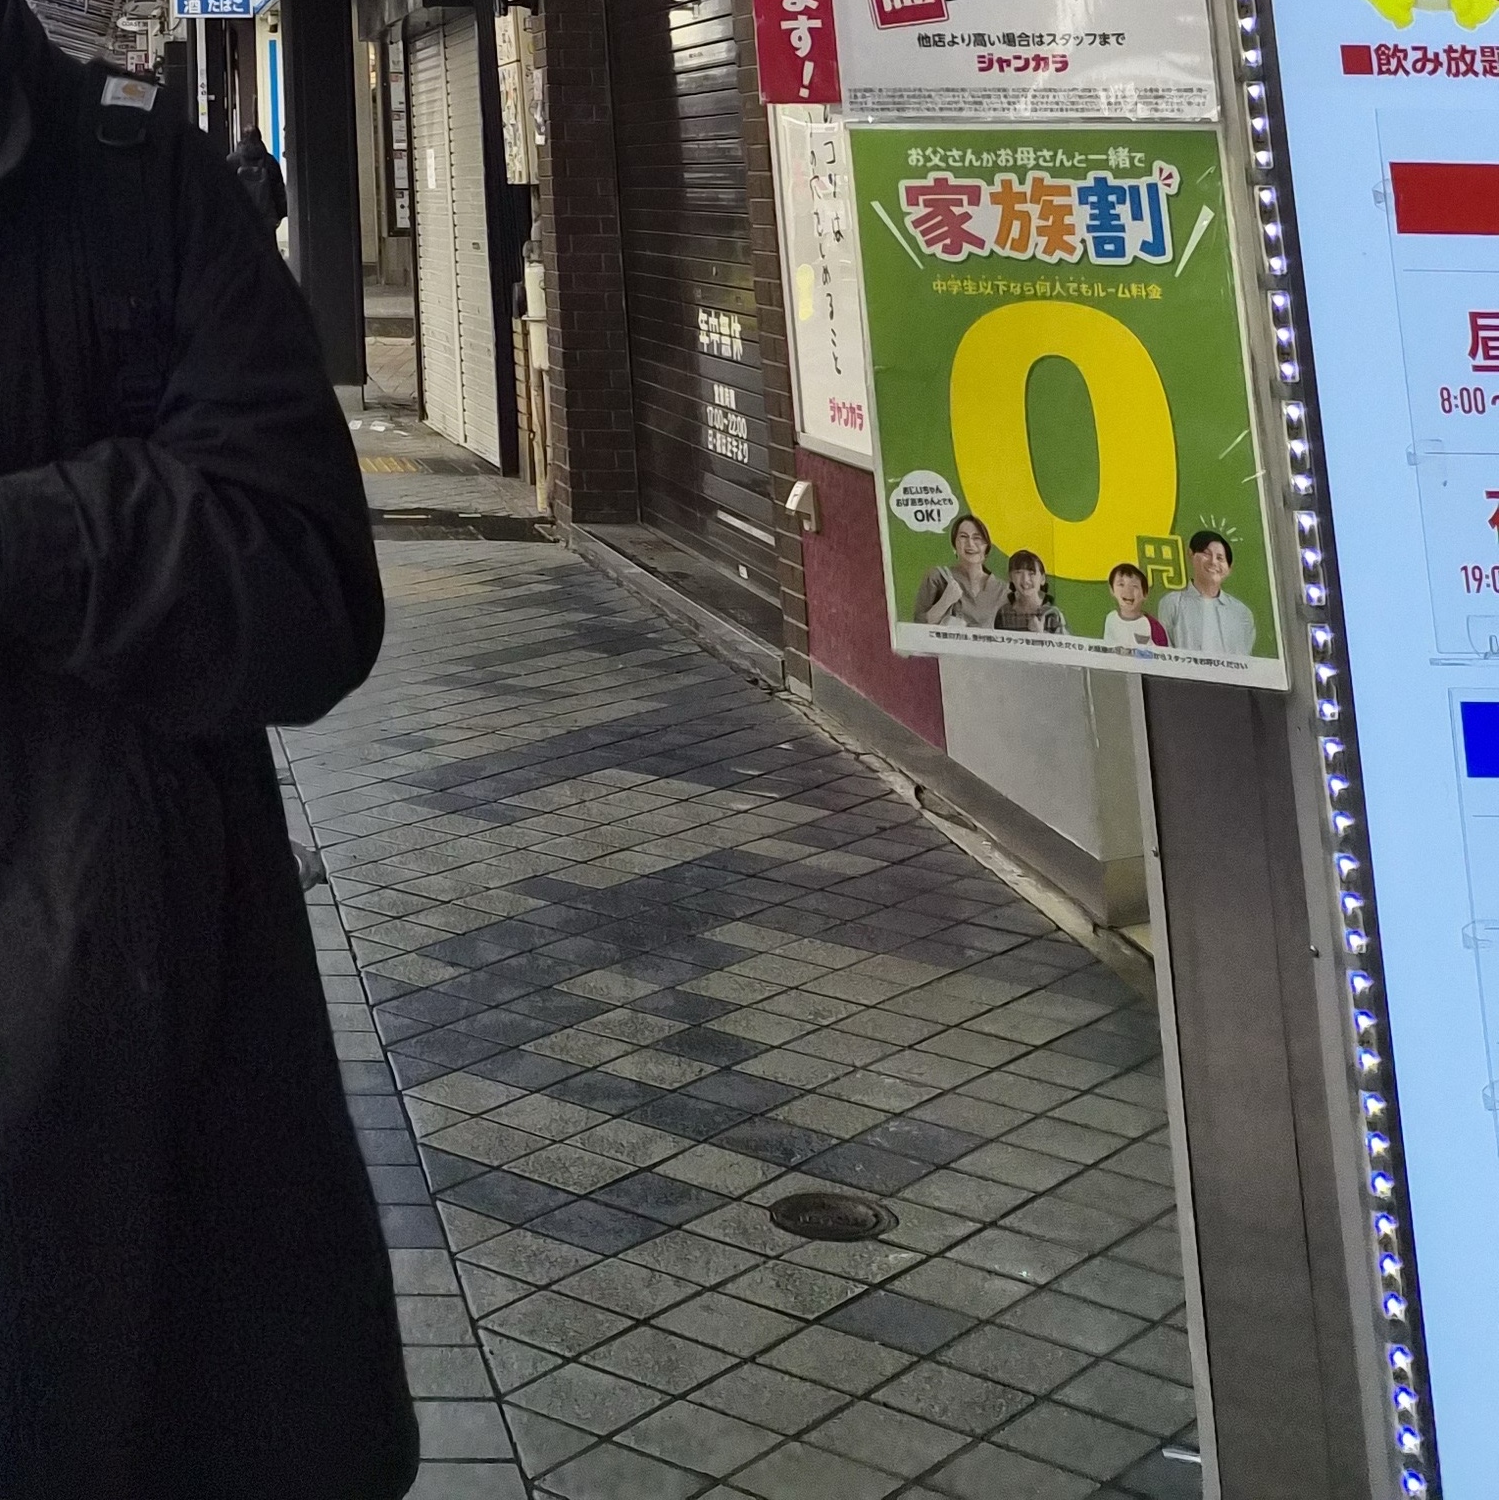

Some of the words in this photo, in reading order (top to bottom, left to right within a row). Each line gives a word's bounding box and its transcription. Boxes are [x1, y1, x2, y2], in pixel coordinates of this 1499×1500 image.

[917, 32, 1126, 48] 他店より高い場合はスタッフまで
[977, 53, 1069, 73] ジャンカラ
[907, 146, 1146, 170] お父さんかお母さんと一緒で
[903, 176, 1167, 260] 家族割
[932, 277, 1163, 300] 中学生以下なら何人でもルーム料金
[829, 397, 864, 432] ジャンカラ
[913, 508, 942, 523] OK!
